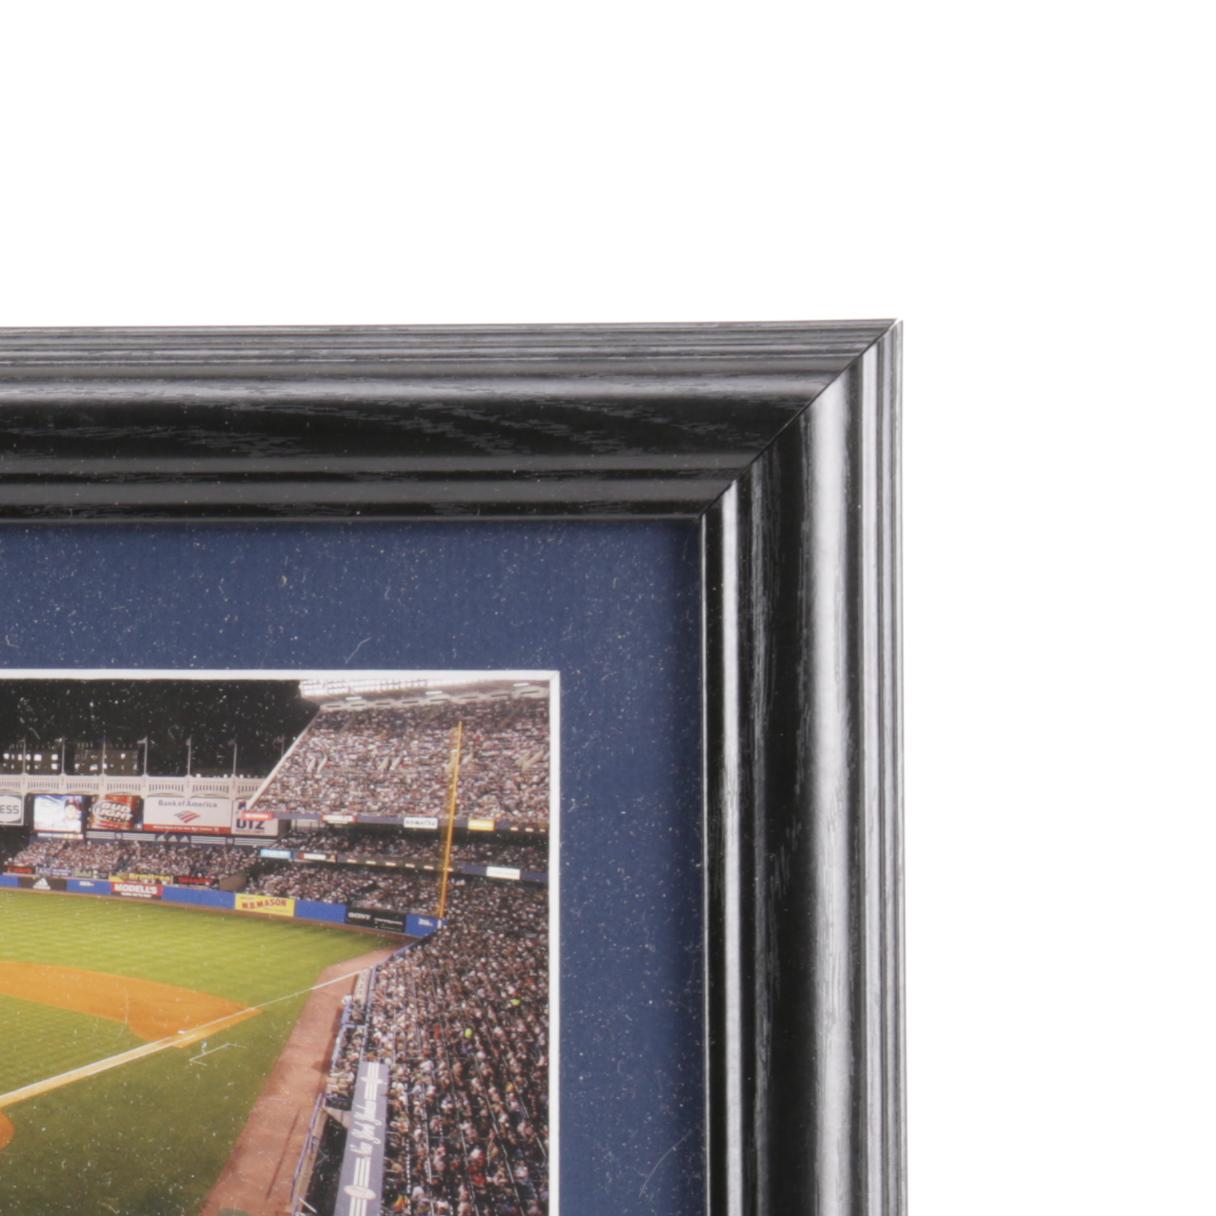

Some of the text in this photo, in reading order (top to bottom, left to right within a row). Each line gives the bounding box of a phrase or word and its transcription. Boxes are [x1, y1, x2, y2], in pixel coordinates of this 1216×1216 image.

[158, 799, 218, 808] Bank of America
